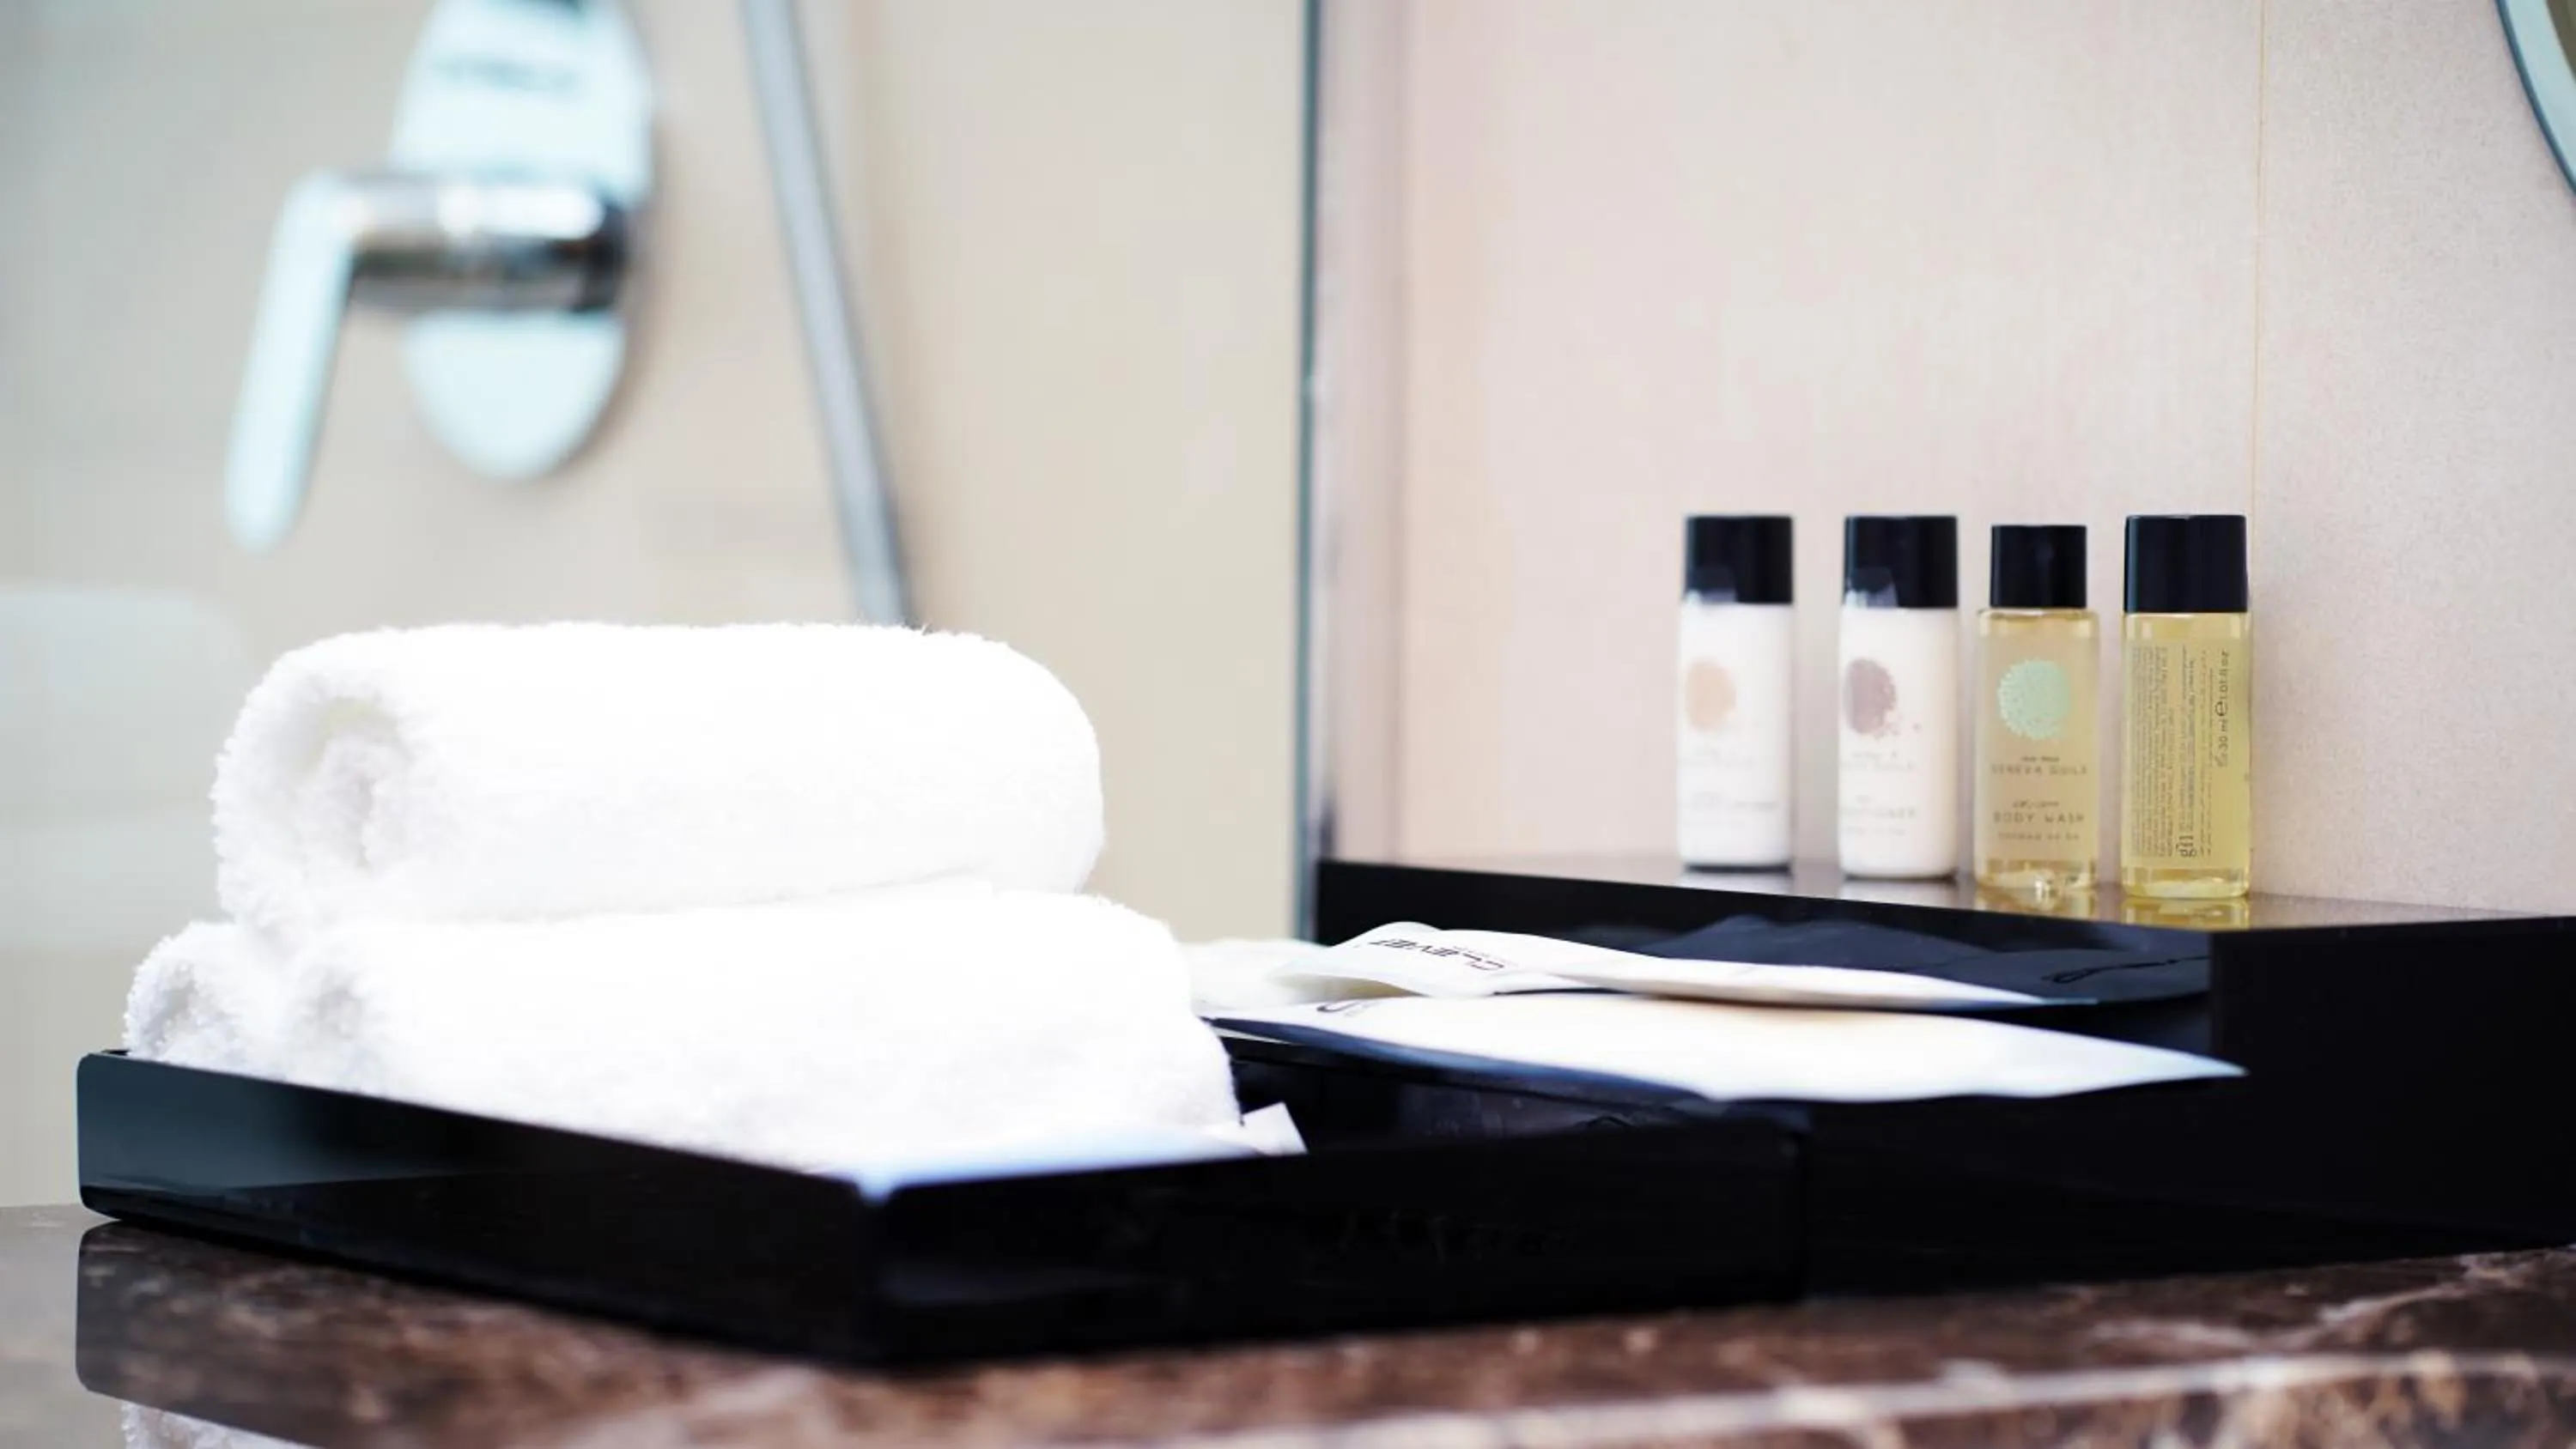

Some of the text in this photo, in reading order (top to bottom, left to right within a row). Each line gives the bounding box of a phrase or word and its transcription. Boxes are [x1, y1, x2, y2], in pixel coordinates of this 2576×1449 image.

[2218, 735, 2229, 753] 30
[1993, 811, 2086, 824] BODY WASH
